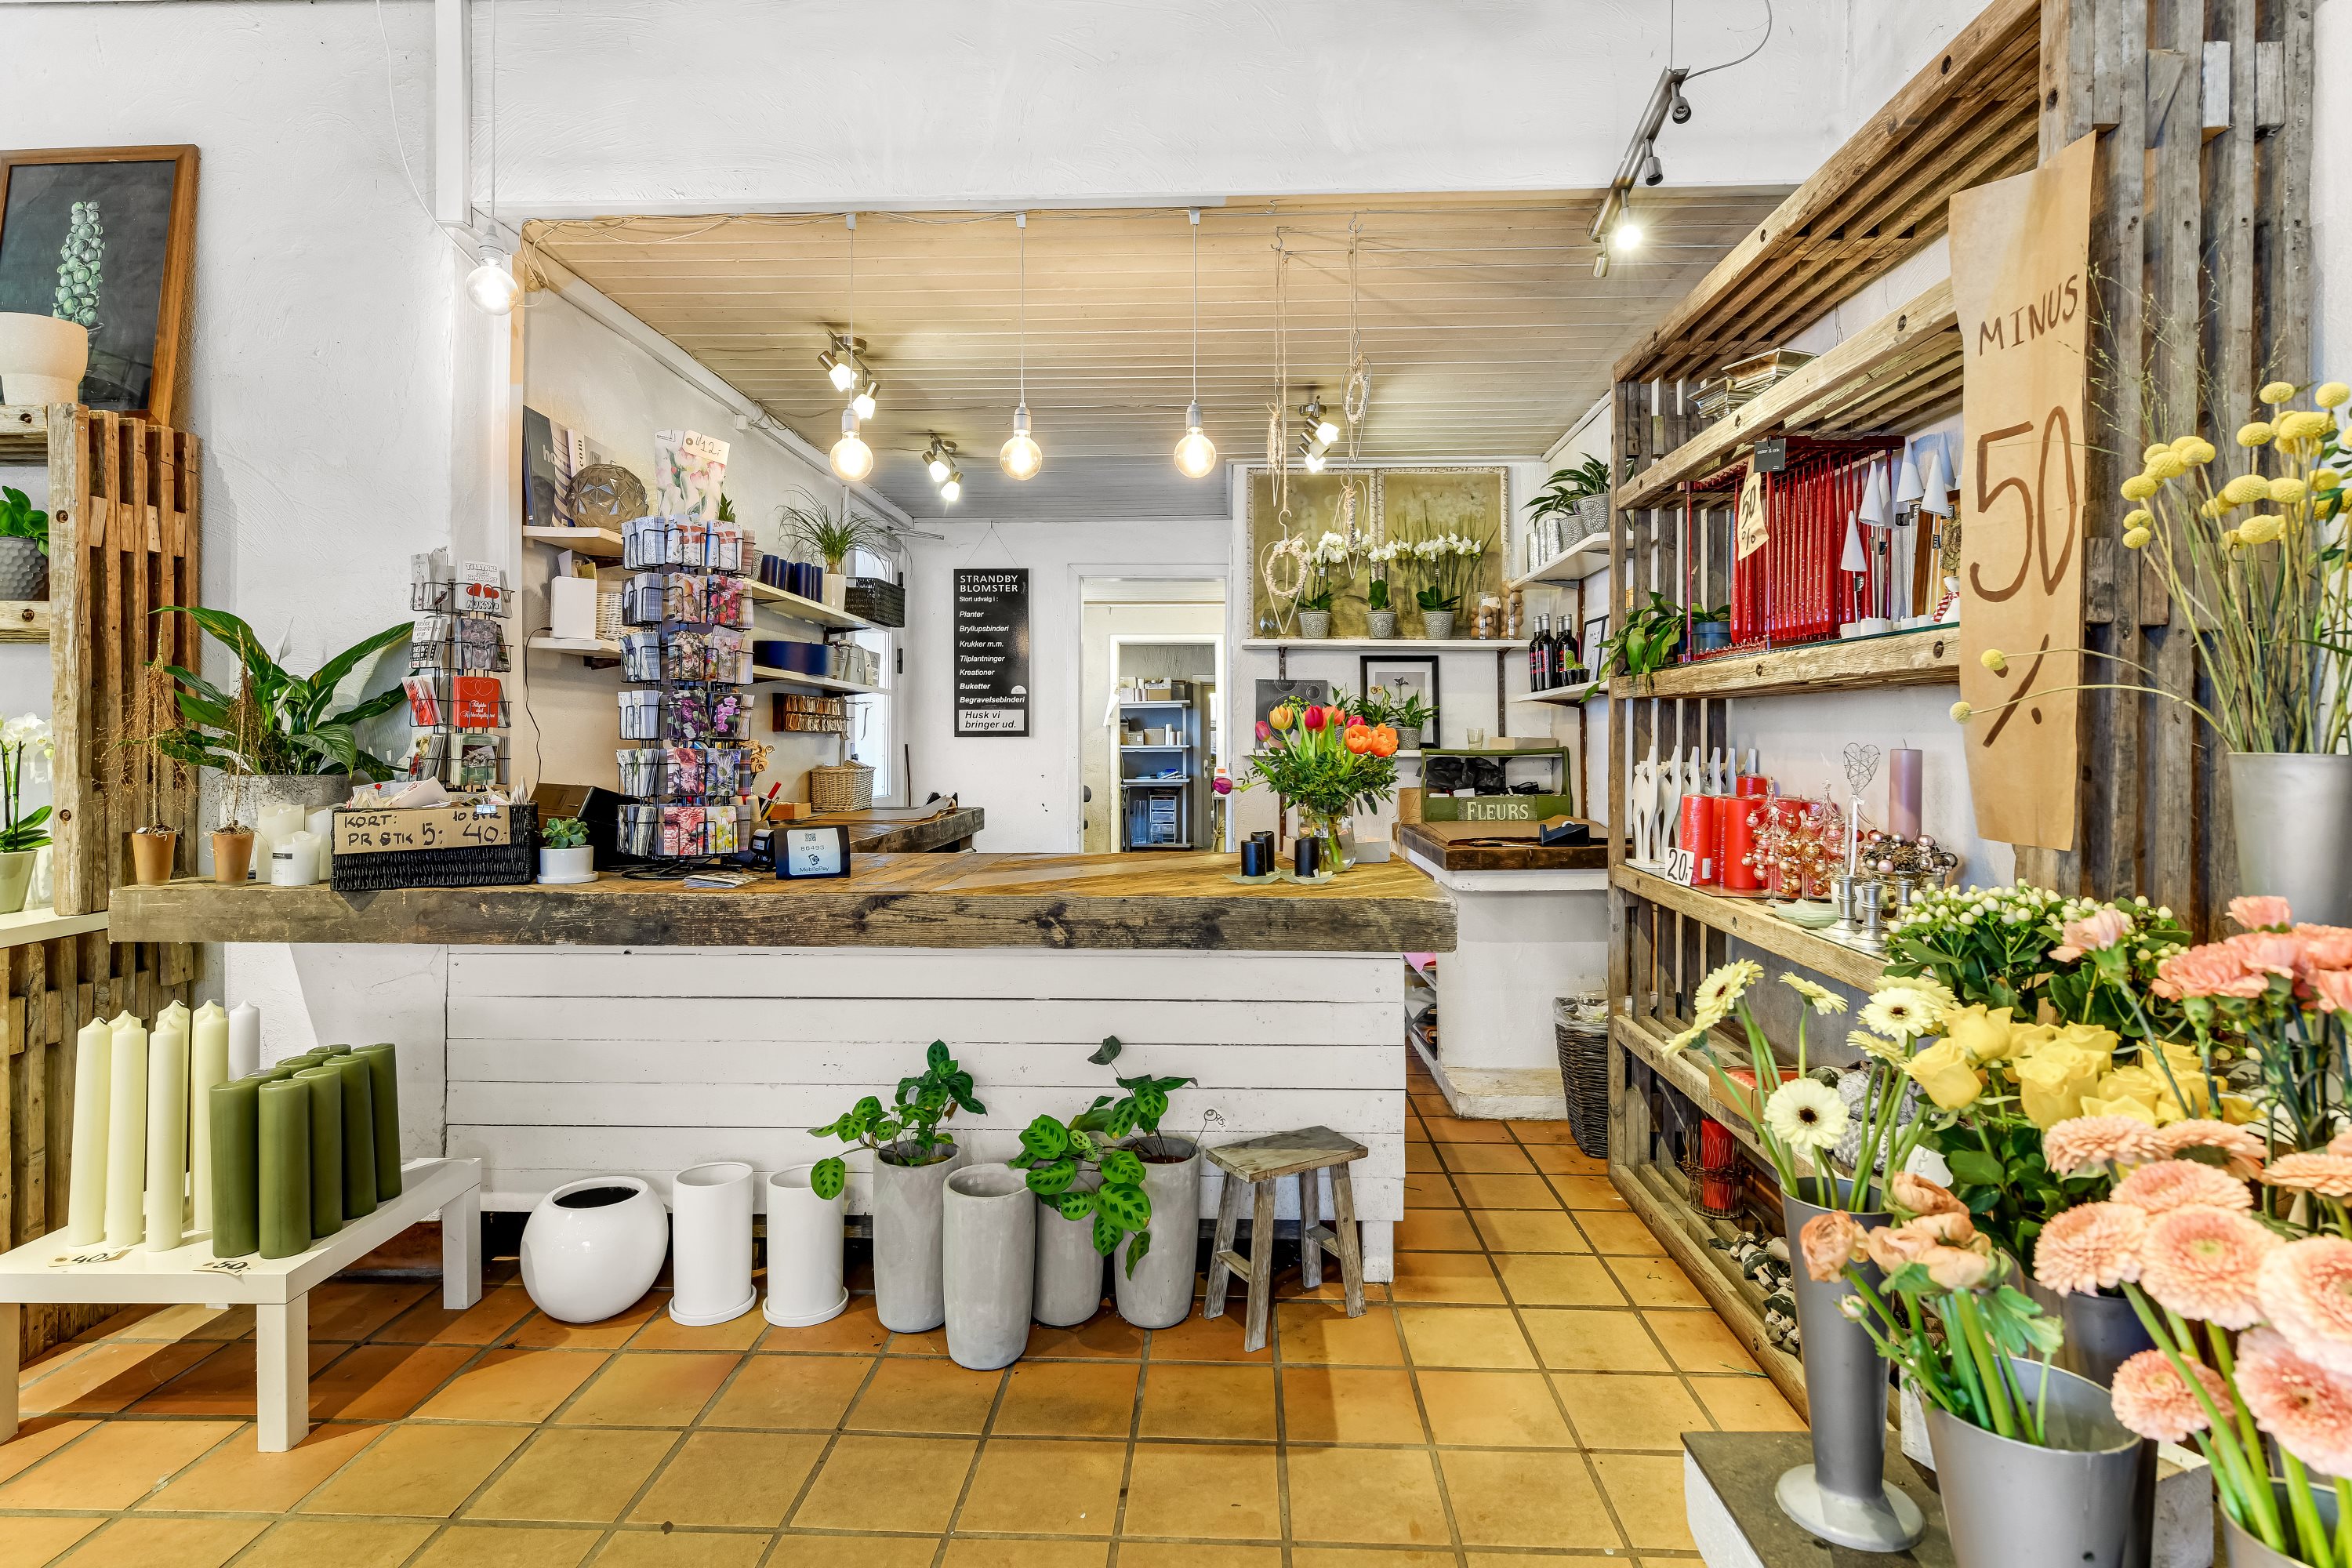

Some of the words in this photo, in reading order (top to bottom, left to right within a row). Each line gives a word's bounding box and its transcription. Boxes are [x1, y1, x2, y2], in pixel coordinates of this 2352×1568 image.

[1979, 274, 2079, 355] MINUS
[1741, 485, 1756, 529] 50
[1969, 405, 2077, 603] 50
[1741, 528, 1756, 550] %
[960, 575, 1018, 583] STRANDBY
[960, 584, 1018, 593] BLOMSTER
[960, 655, 1005, 663] Tilplantninger
[965, 710, 989, 719] Husk
[992, 710, 1001, 719] vi
[964, 720, 1000, 730] bringer
[1002, 720, 1016, 728] ud.
[452, 810, 466, 822] 10
[1466, 801, 1529, 820] FLEURS
[344, 815, 398, 829] KORT:
[347, 833, 372, 847] PR
[379, 831, 414, 847] STK
